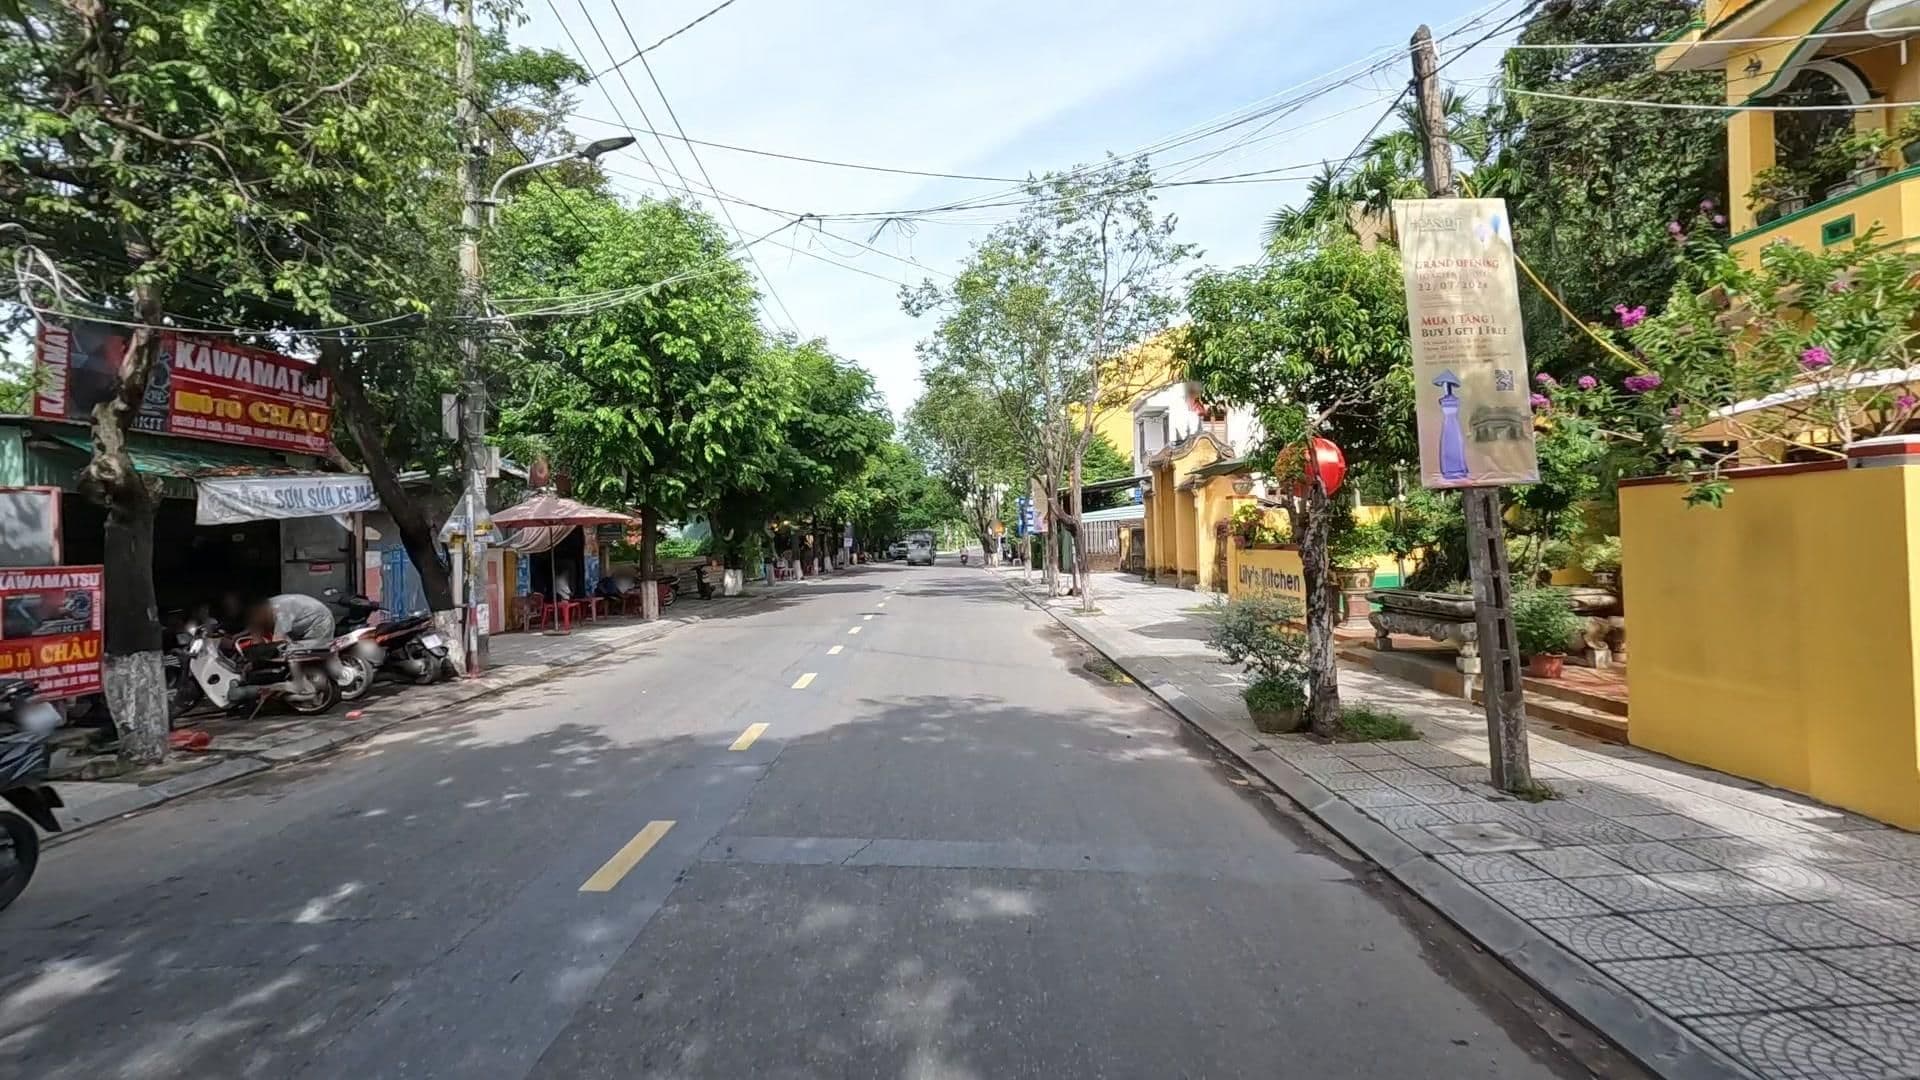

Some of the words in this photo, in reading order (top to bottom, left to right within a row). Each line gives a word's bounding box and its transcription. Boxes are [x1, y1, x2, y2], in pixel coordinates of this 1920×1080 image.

[1422, 315, 1448, 326] MUA
[1422, 327, 1444, 338] BUY
[175, 340, 329, 400] KAWAMATSU
[1239, 562, 1260, 588] Lily's
[1261, 567, 1301, 592] Kitchen
[41, 637, 99, 664] CHÂU
